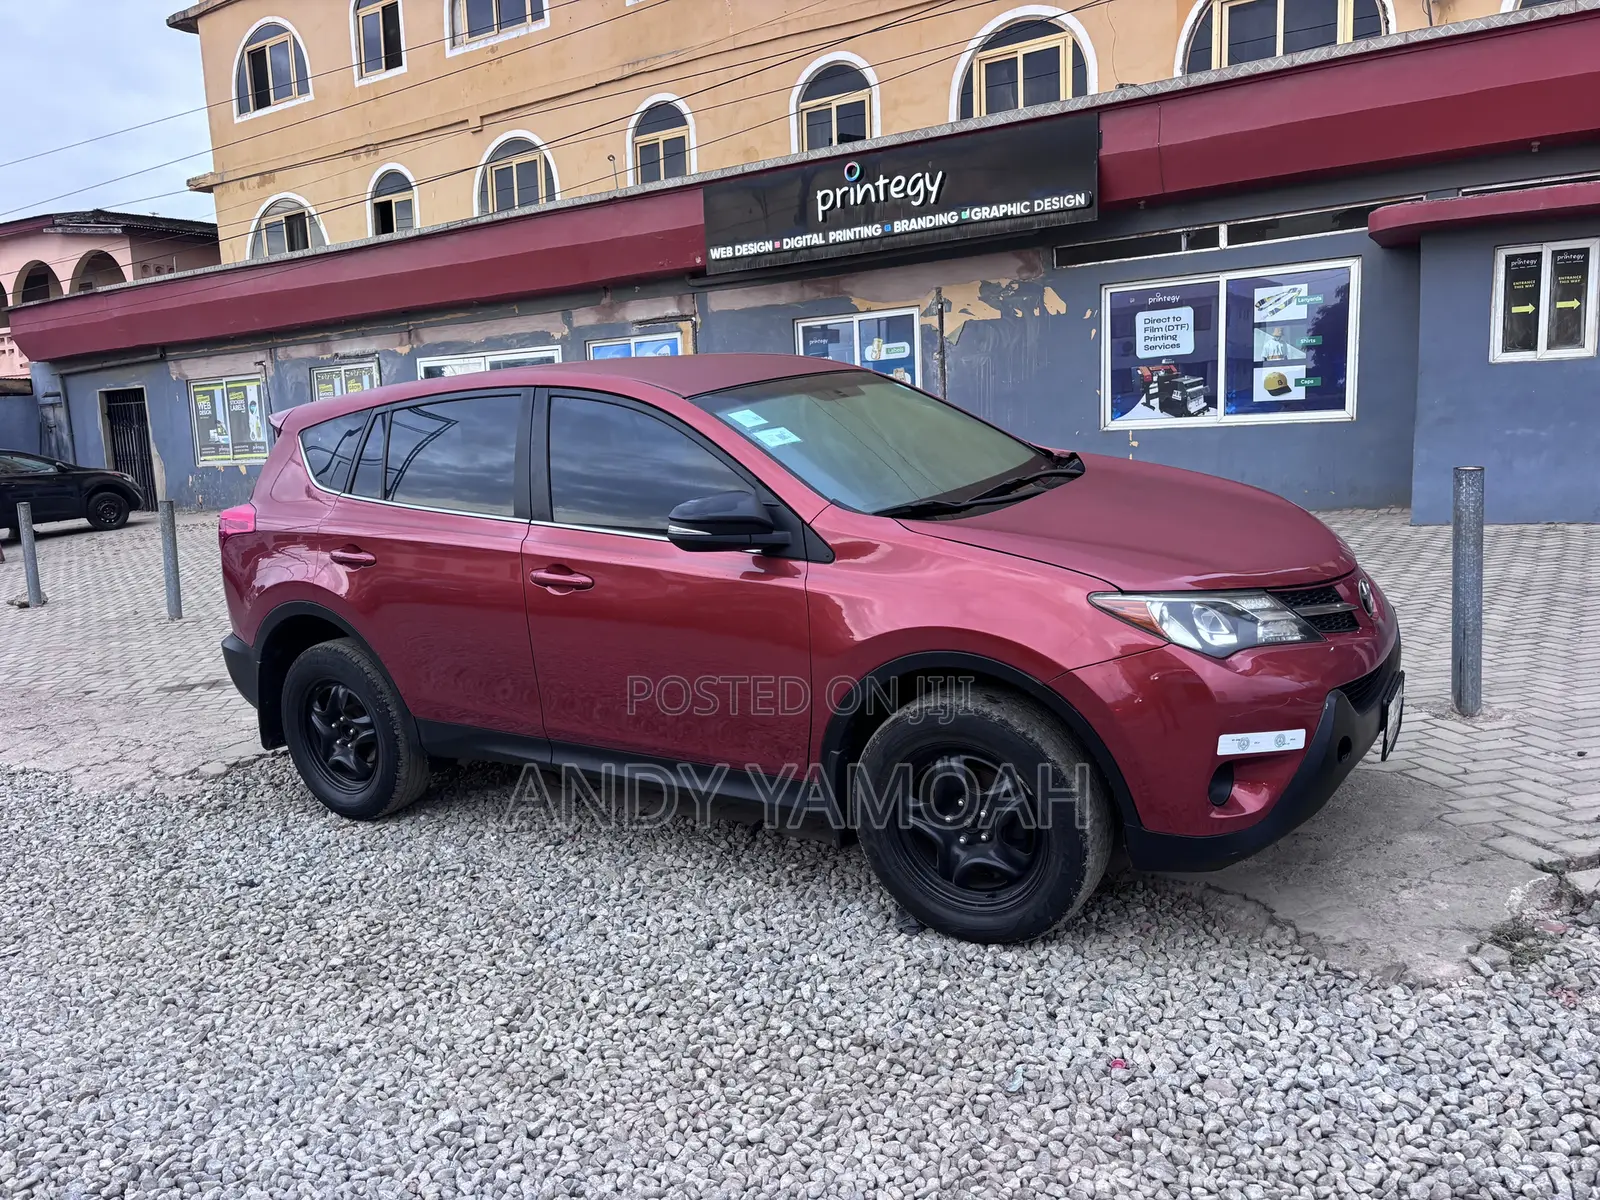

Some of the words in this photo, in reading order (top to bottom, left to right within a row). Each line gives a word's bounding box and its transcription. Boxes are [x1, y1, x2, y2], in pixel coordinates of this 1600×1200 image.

[816, 161, 943, 222] printegy
[710, 248, 733, 260] WEB
[735, 241, 773, 256] DESIGN
[782, 233, 825, 249] DIGITAL
[829, 224, 882, 243] PRINTING
[893, 211, 958, 233] BRANDING
[971, 201, 1031, 220] GRAPHIC
[1034, 192, 1086, 212] DESIGN
[1557, 252, 1584, 261] printegy
[1511, 257, 1537, 267] printegy
[1148, 292, 1180, 305] printegy
[1144, 317, 1171, 325] Direct
[1165, 323, 1189, 332] (DTF)
[1144, 334, 1178, 342] Printing
[1144, 343, 1181, 351] Services
[197, 401, 211, 410] WEB
